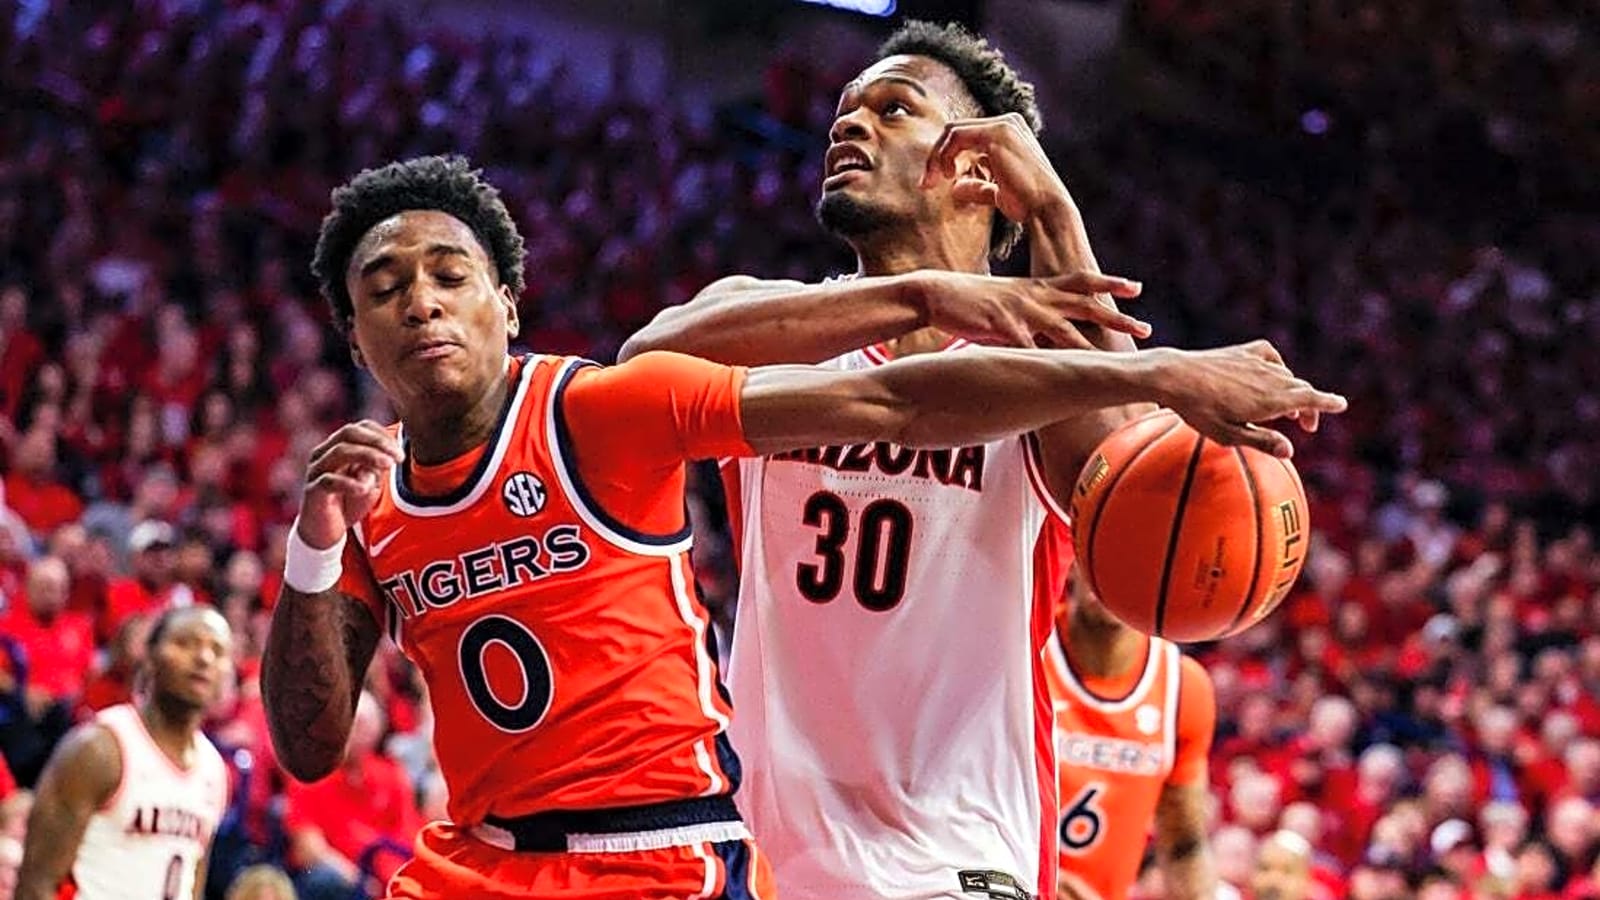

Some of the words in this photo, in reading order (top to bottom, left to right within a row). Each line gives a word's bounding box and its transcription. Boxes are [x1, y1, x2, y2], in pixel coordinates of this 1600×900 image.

[504, 473, 546, 516] SEC
[765, 441, 988, 493] IZONA
[380, 524, 591, 620] TIGERS
[796, 490, 914, 612] 30
[458, 614, 554, 734] 0
[1060, 786, 1101, 850] 6
